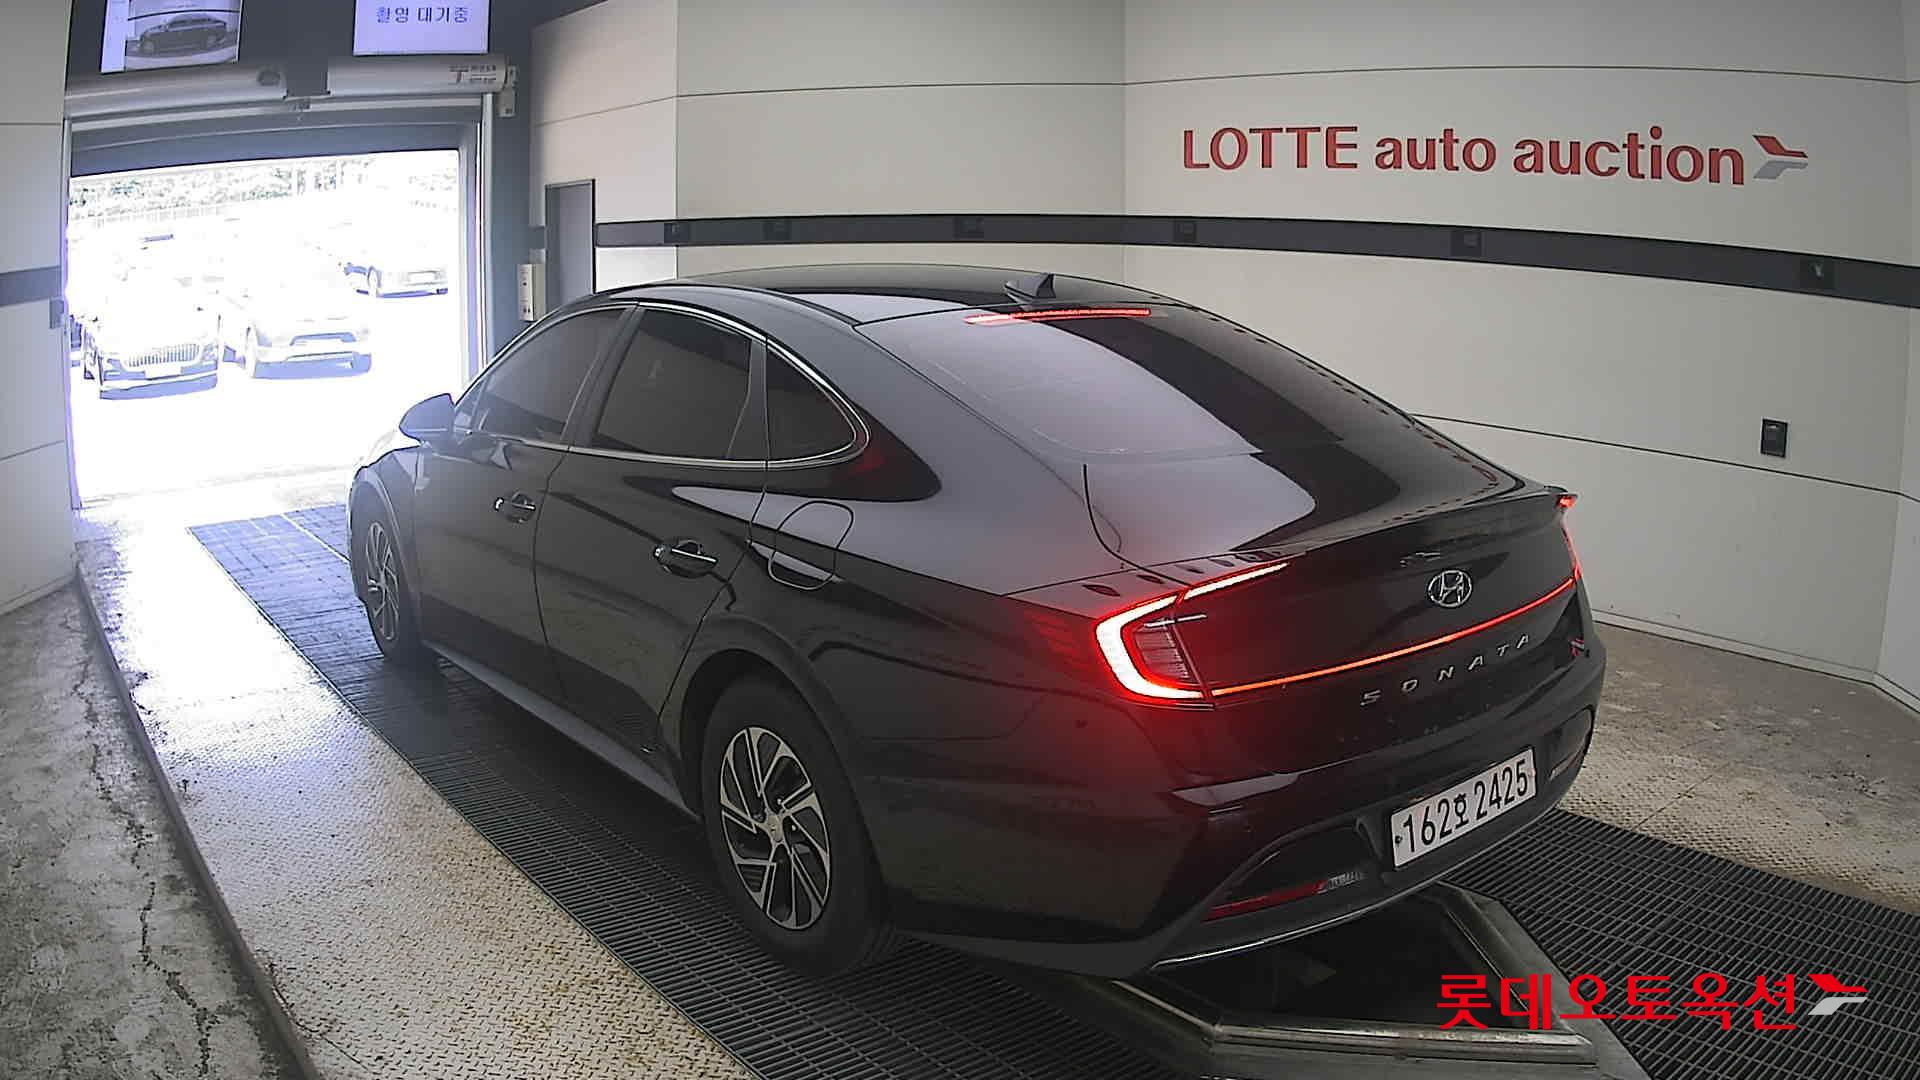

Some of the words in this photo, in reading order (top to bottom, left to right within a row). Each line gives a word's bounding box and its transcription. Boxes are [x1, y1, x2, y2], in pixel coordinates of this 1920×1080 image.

[417, 7, 468, 23] 대기중
[1183, 126, 1358, 170] LOTTE
[1374, 128, 1496, 172] auto
[1513, 126, 1744, 185] auction
[1360, 634, 1530, 706] SONATA
[1474, 759, 1528, 820] 2425
